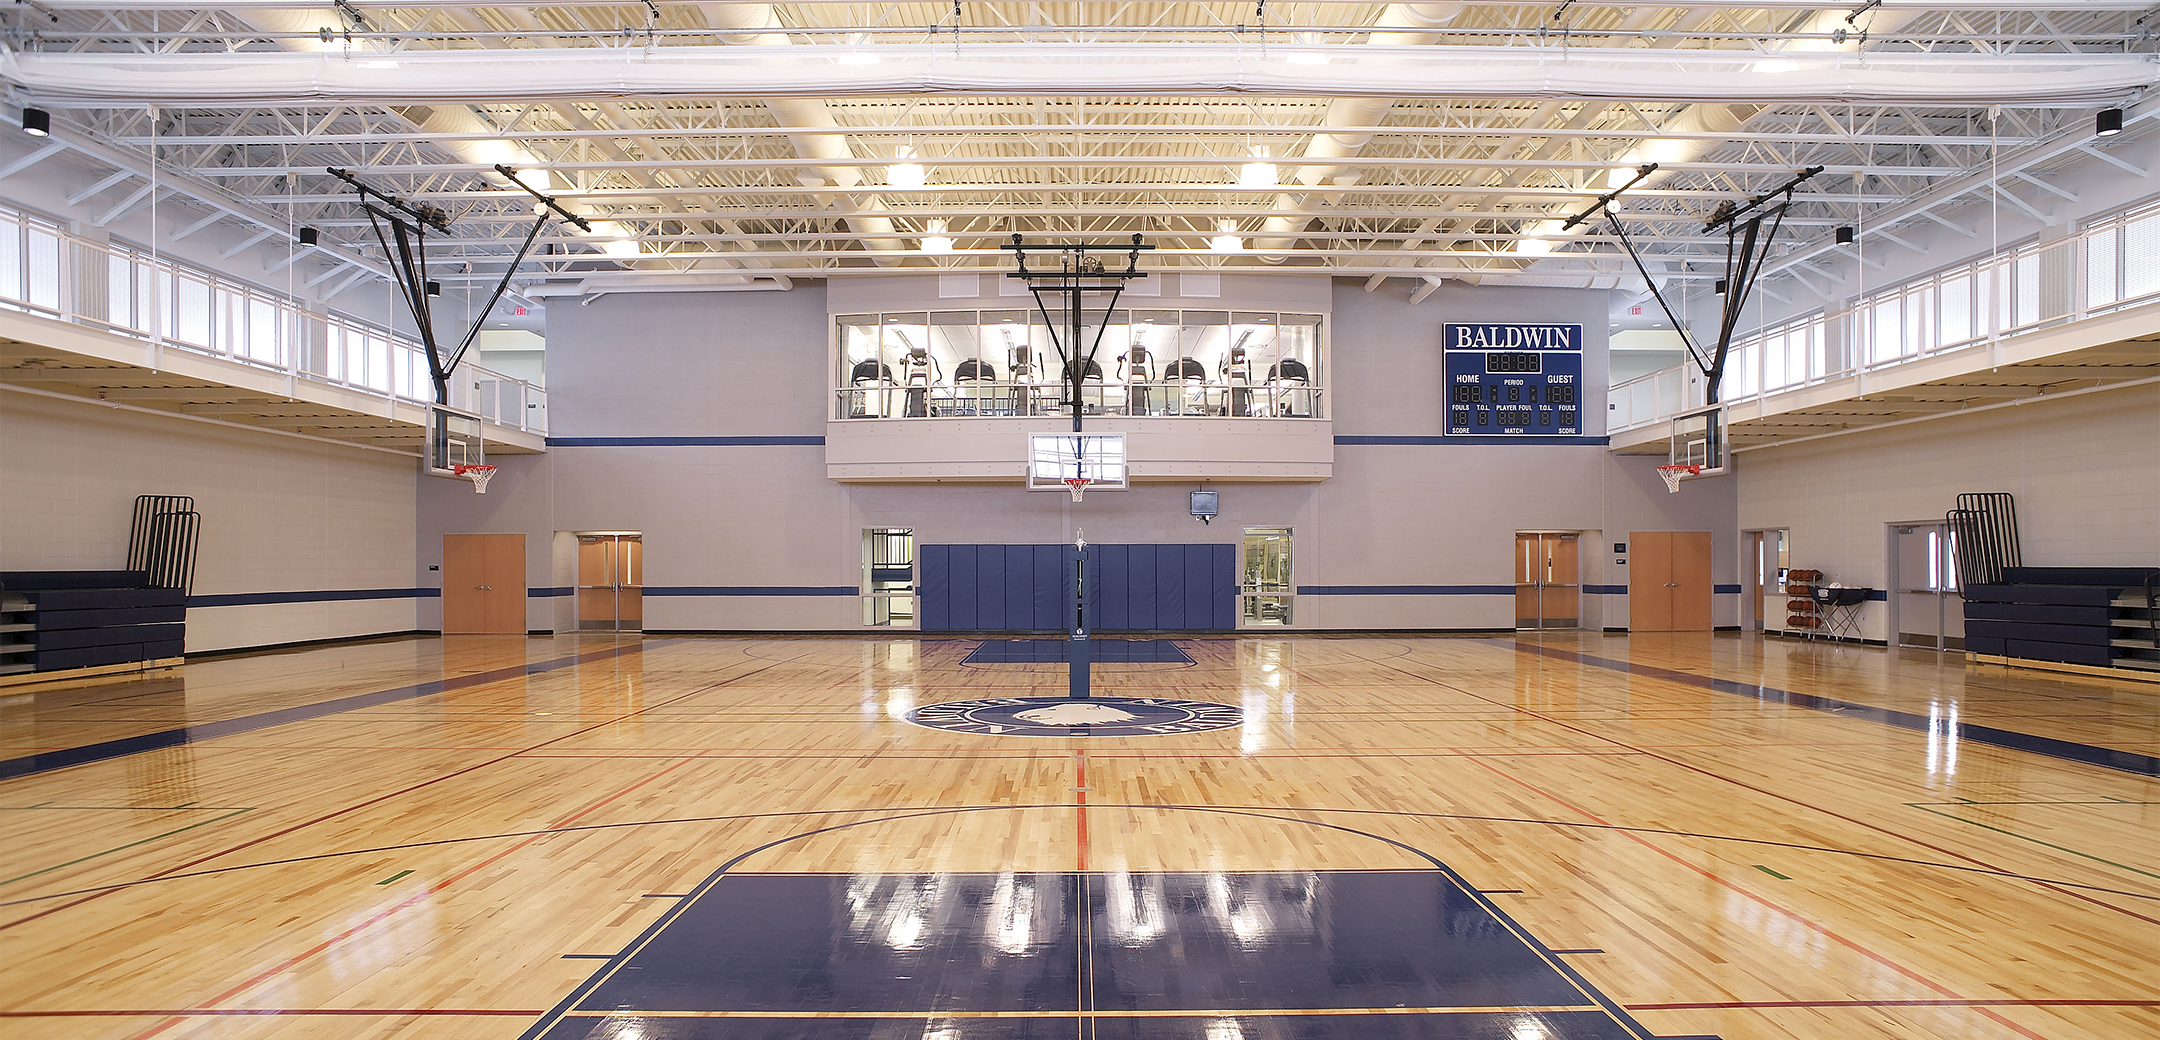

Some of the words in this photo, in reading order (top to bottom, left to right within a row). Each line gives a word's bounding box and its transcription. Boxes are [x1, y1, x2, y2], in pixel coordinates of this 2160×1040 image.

[516, 306, 526, 316] EXIT
[1632, 307, 1642, 315] EXIT
[1456, 327, 1571, 348] BALDWIN
[1456, 375, 1479, 383] HOME
[1548, 375, 1573, 383] GUEST
